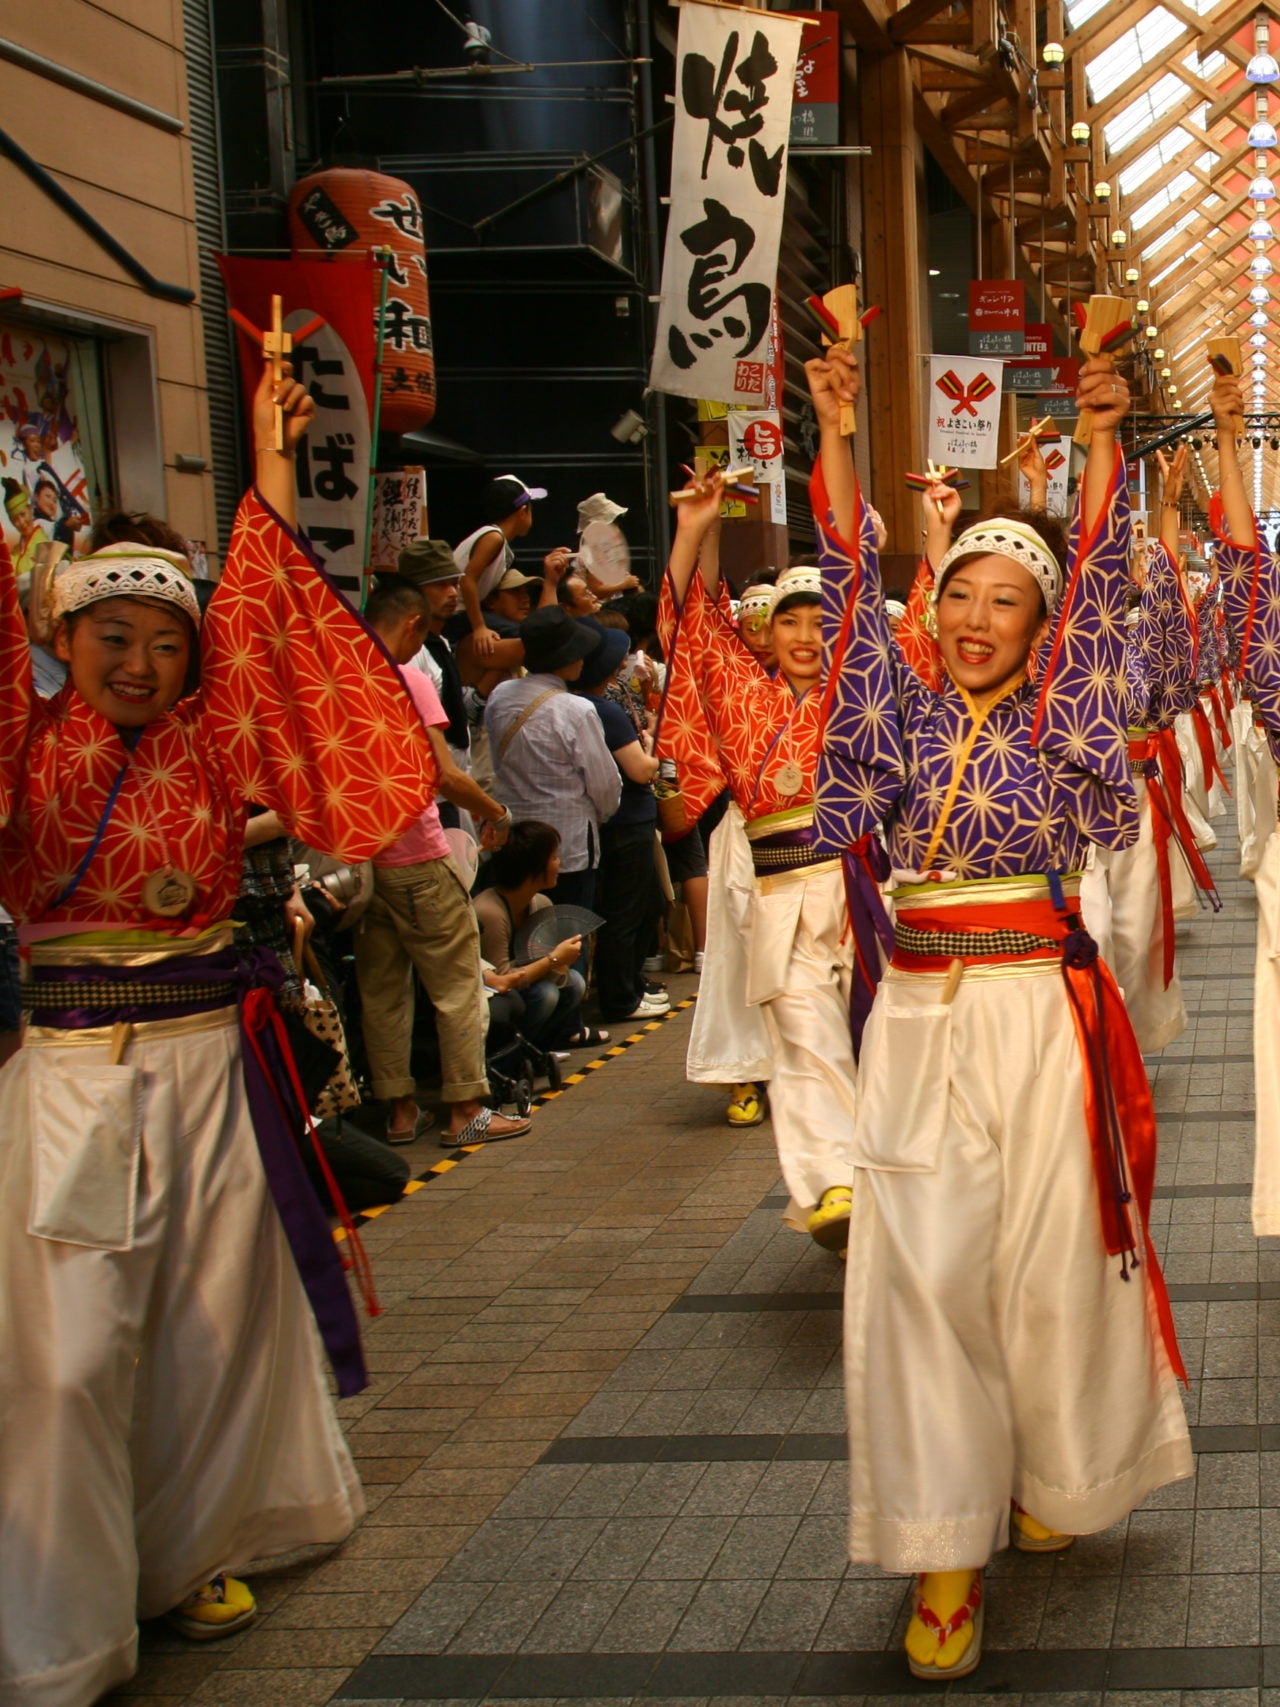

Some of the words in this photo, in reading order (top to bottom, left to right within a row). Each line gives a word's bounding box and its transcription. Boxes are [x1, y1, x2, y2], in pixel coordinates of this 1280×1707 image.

[668, 29, 785, 369] 焼鳥
[290, 344, 361, 594] たばこ
[947, 417, 993, 432] よさこい祭り
